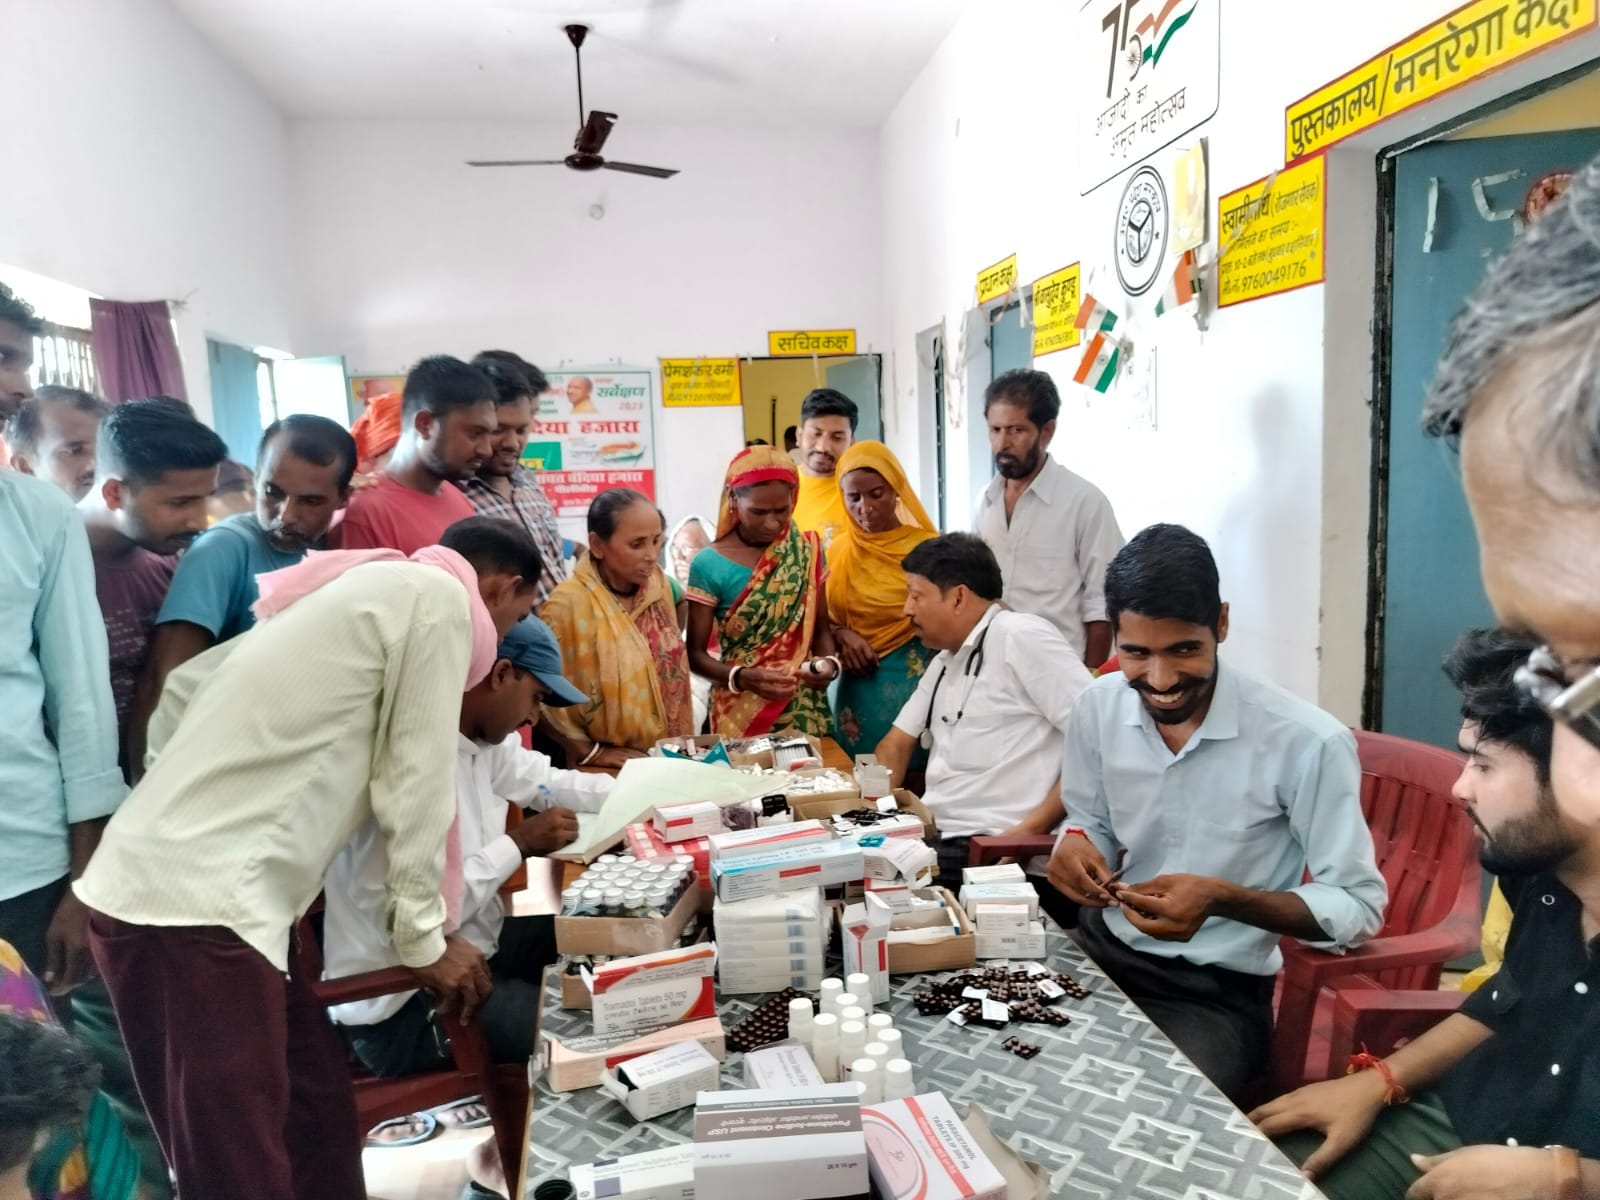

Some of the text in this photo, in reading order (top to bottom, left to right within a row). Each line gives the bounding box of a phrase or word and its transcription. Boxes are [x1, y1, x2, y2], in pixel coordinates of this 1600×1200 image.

[1140, 86, 1187, 133] महोत्सव
[1241, 259, 1308, 293] 9760049176
[778, 332, 849, 351] सचिव कक्ष
[597, 384, 645, 398] सर्वेक्षण
[578, 420, 640, 435] हजारा
[932, 1115, 953, 1142] TABLETS
[944, 1119, 977, 1160] PARACETAMOL
